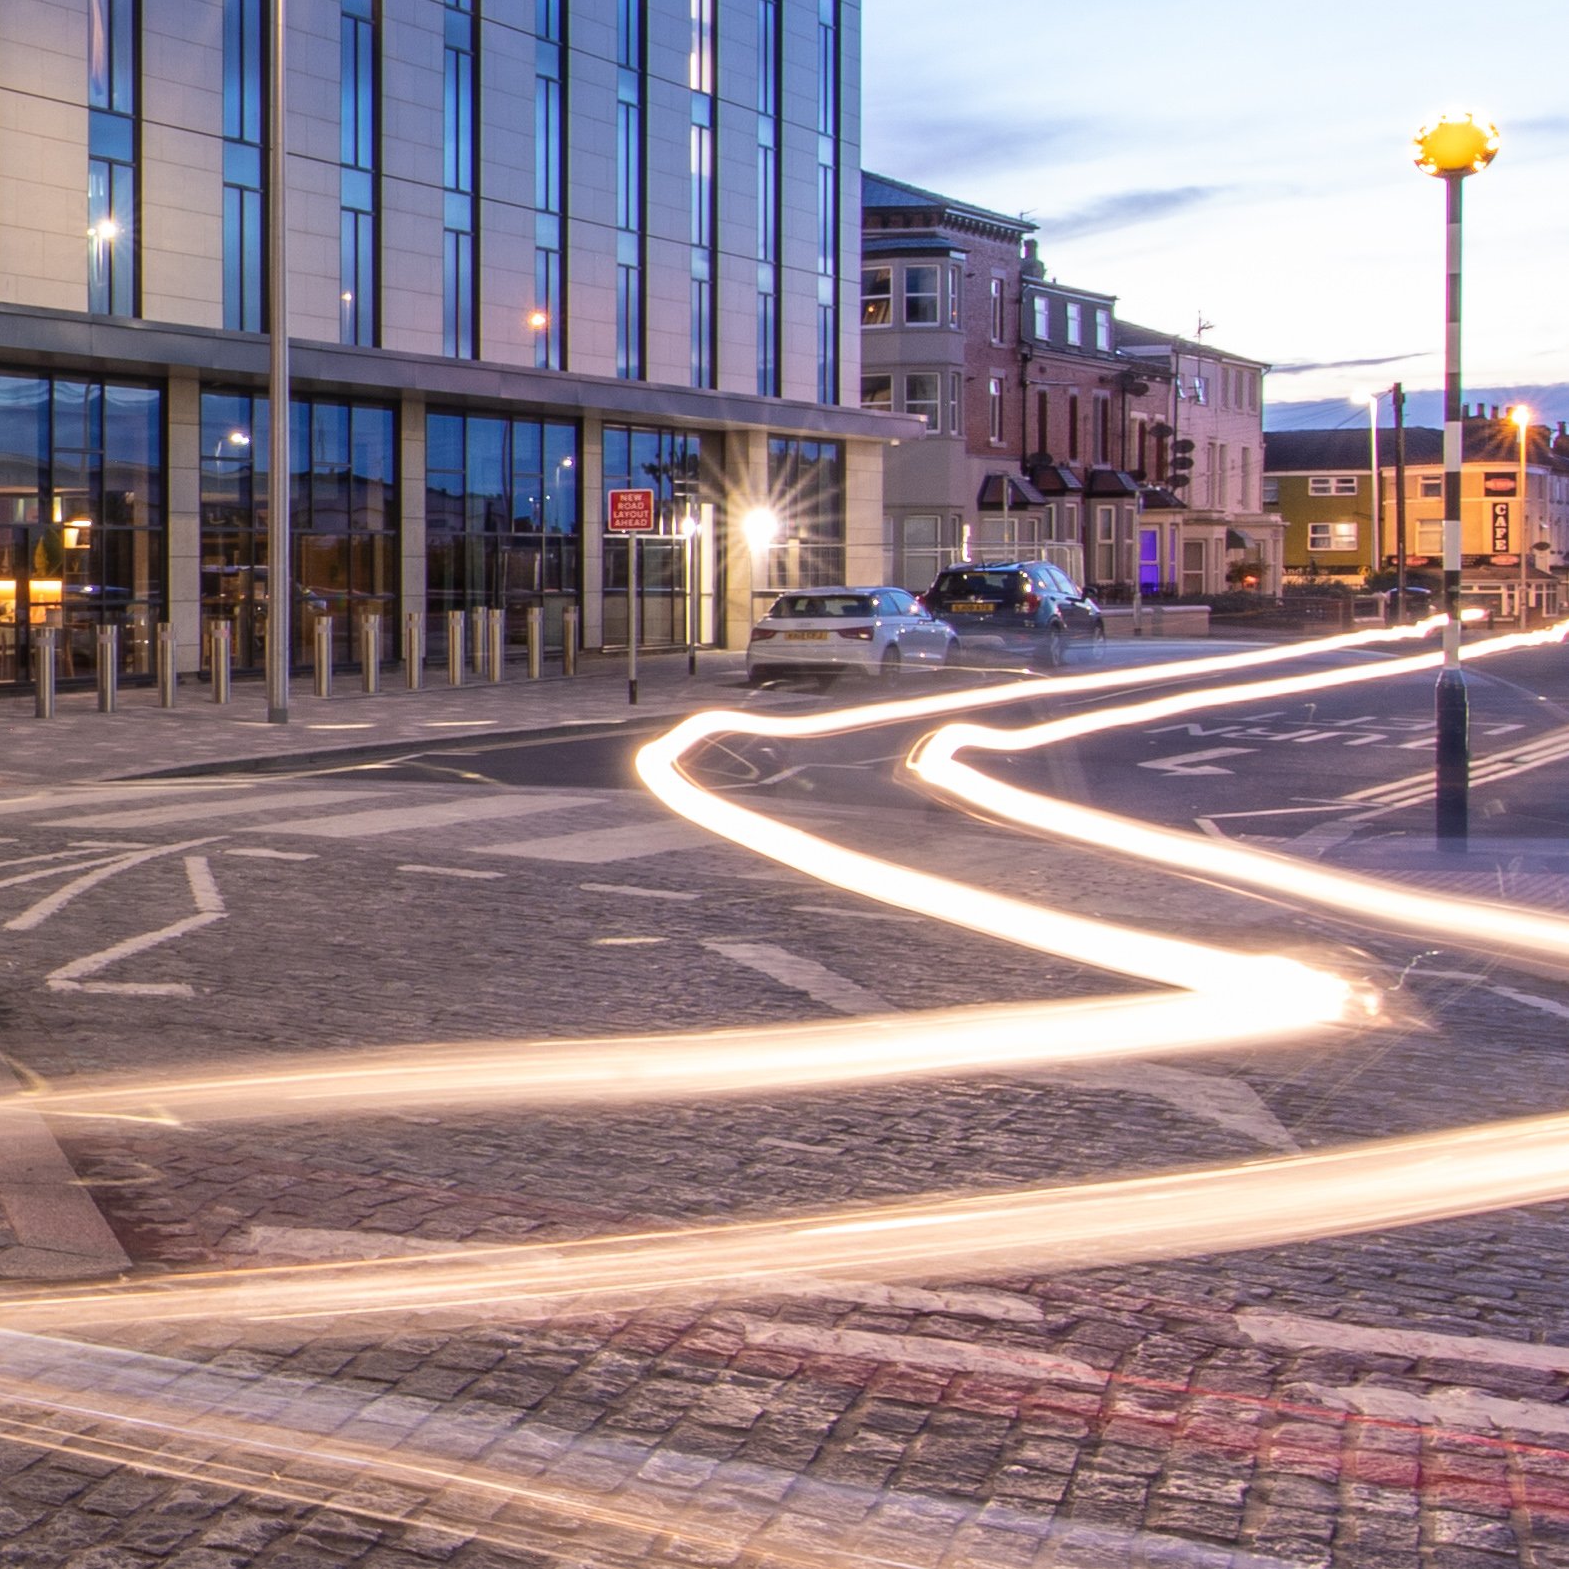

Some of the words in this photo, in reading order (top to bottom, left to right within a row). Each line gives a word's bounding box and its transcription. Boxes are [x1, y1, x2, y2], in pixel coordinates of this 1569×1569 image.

[619, 493, 642, 502] NEW
[617, 502, 644, 510] ROAD
[613, 510, 649, 519] LAYOUT
[614, 518, 647, 527] AHEAD
[1494, 504, 1507, 551] CAFE
